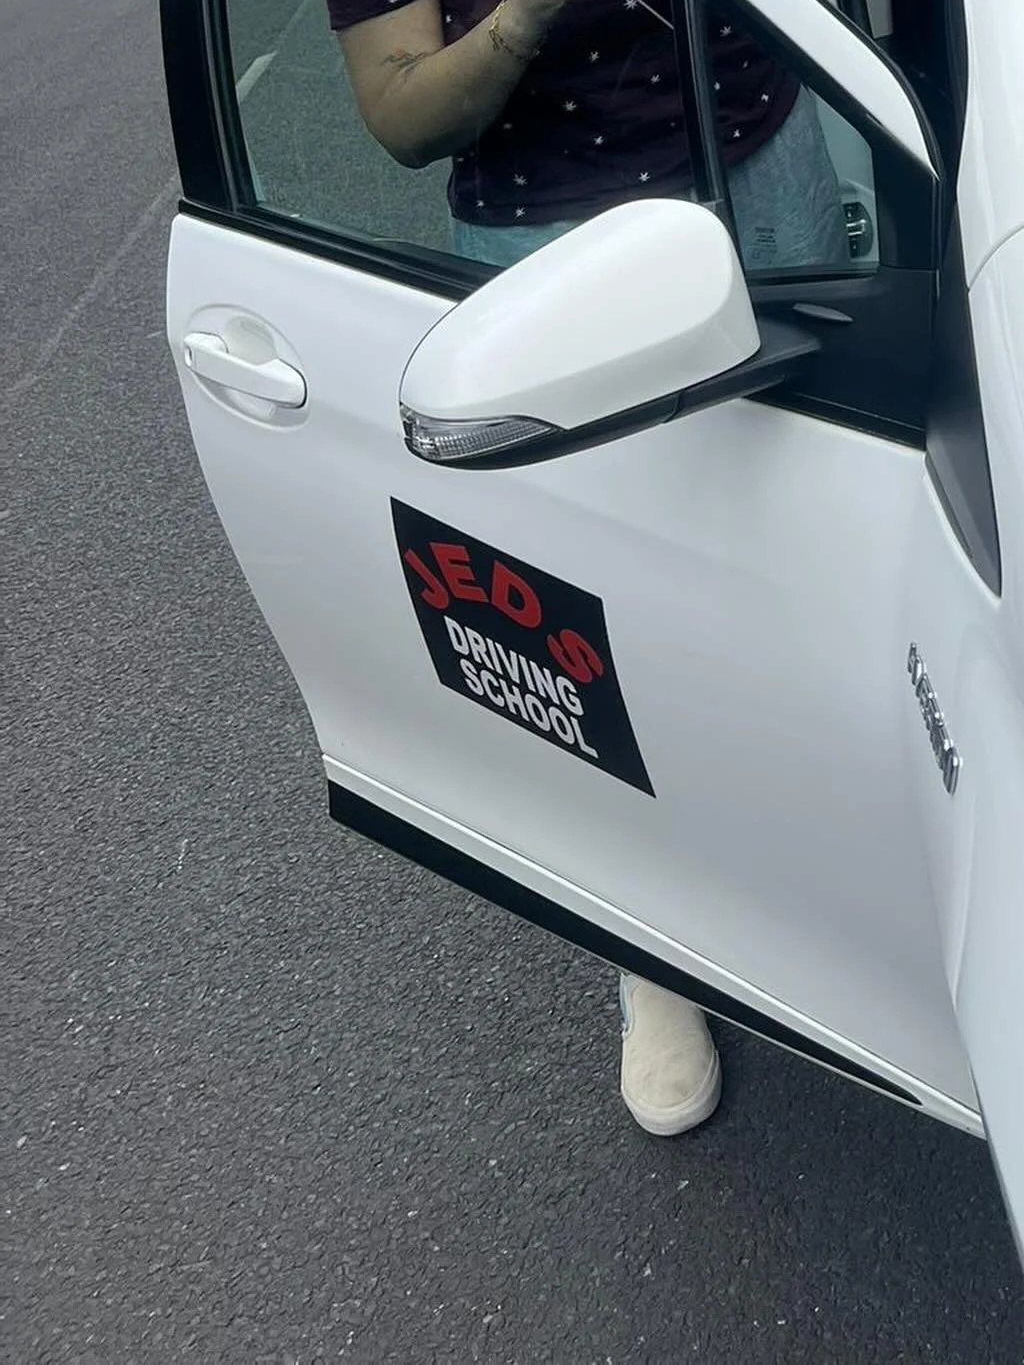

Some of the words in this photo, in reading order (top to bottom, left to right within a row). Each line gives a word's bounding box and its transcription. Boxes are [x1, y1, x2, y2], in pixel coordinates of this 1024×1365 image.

[403, 541, 604, 683] JEDS
[444, 616, 583, 716] DRIVING
[460, 659, 598, 759] SCHOOL
